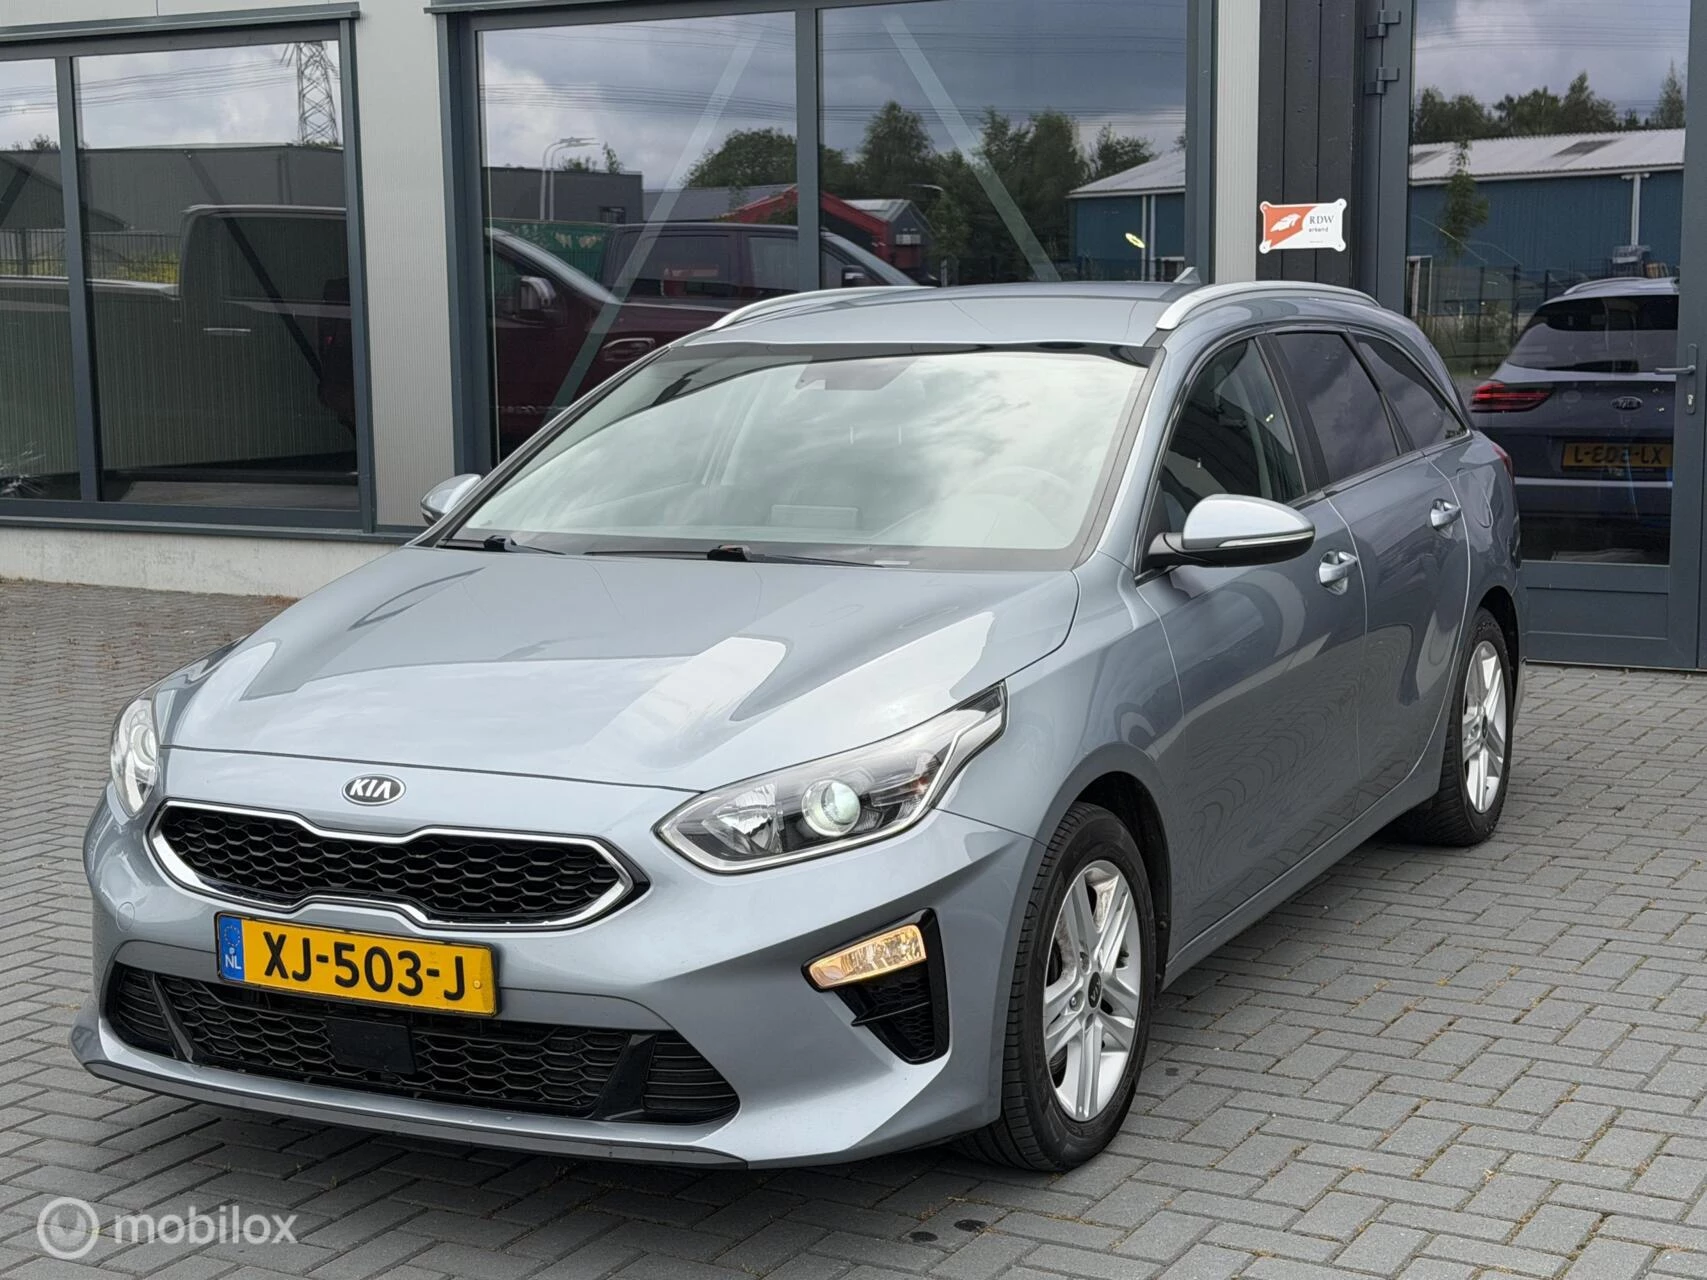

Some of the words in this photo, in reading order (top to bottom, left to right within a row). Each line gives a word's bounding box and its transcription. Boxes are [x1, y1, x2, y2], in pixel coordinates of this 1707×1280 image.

[1309, 215, 1334, 225] RDW
[349, 778, 391, 799] KIA
[225, 953, 242, 970] NL
[264, 932, 465, 1001] XJ-503-J
